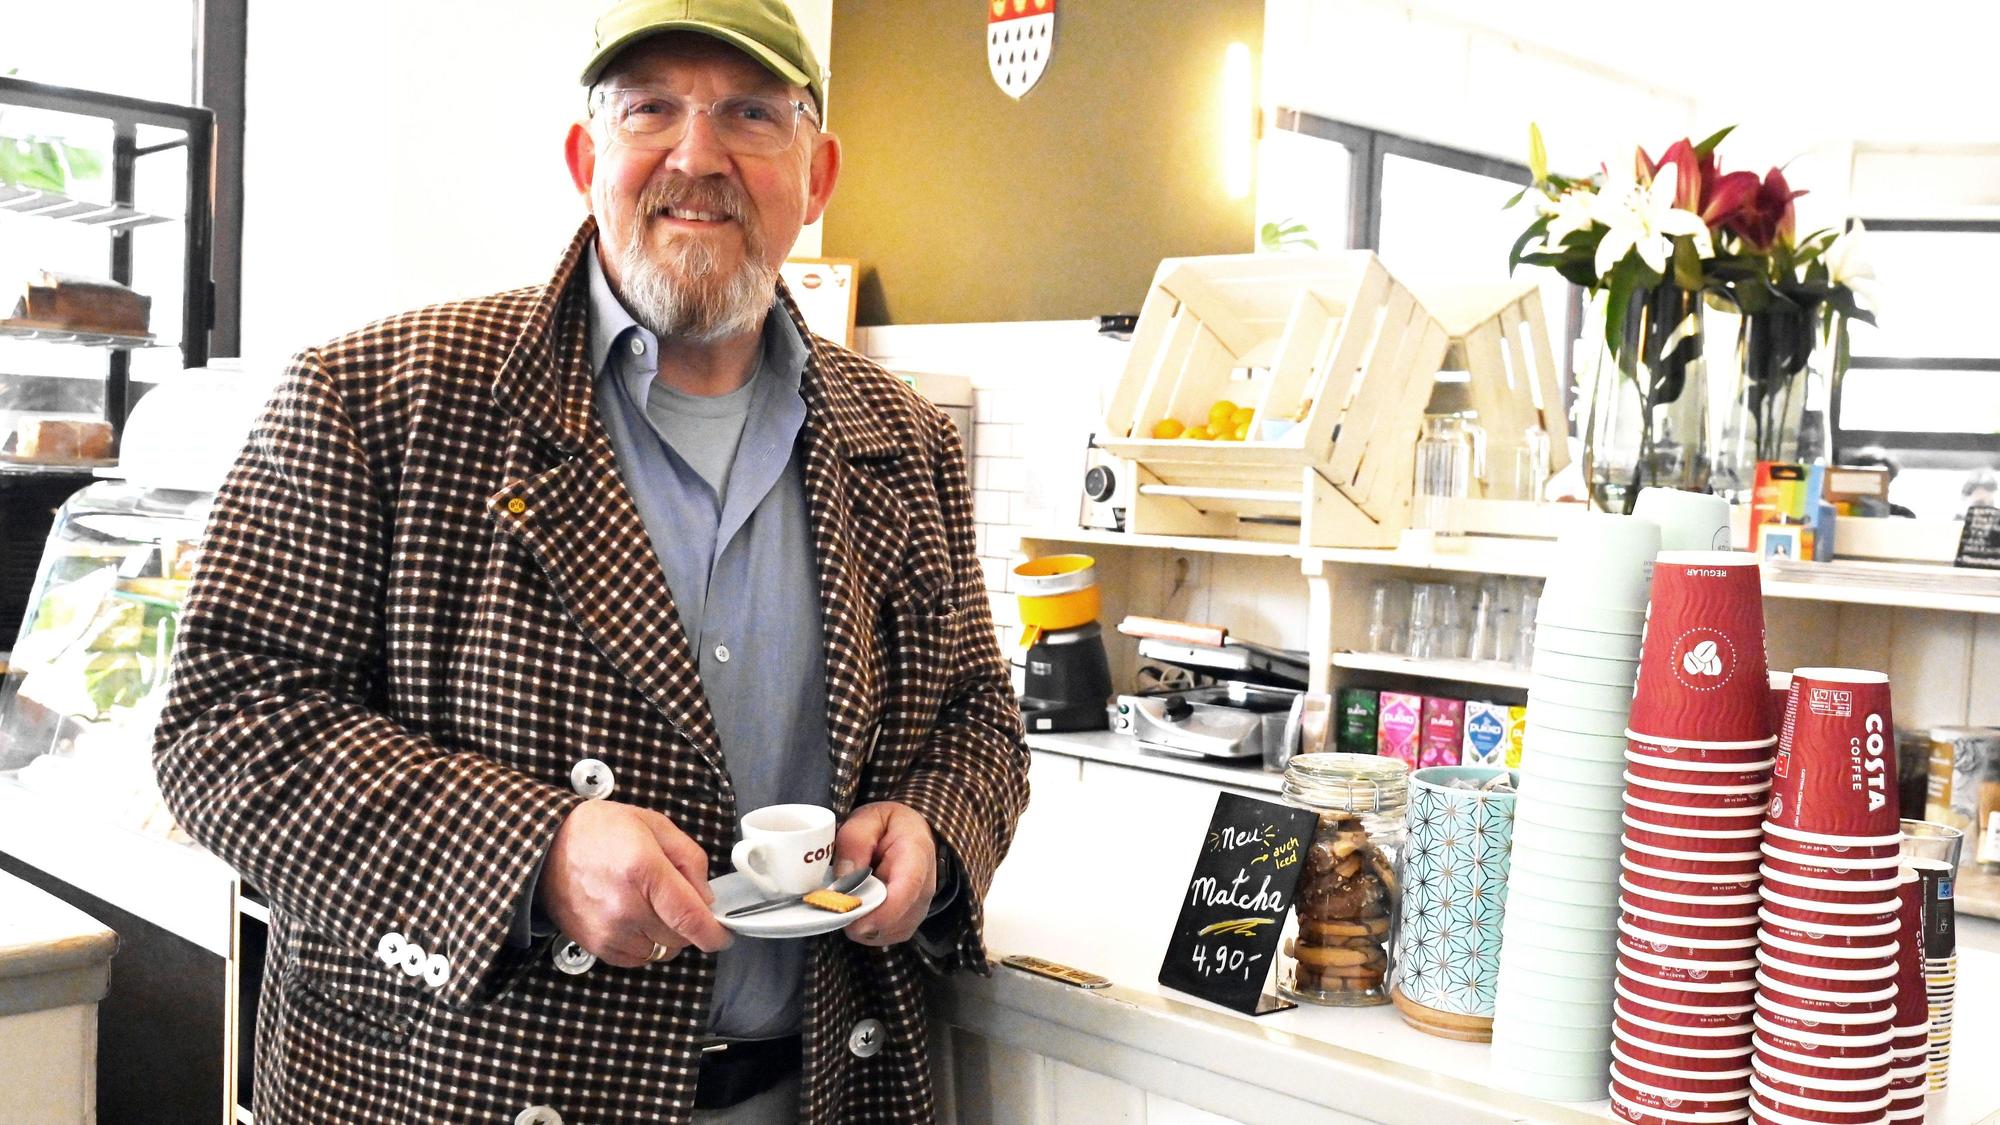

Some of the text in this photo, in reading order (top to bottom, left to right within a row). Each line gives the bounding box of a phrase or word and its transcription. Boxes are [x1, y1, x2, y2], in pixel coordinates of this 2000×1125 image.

[1686, 568, 1727, 577] REGULAR
[1850, 737, 1862, 791] COFFEE
[1864, 713, 1886, 812] COSTA
[1222, 826, 1262, 850] Neu
[1273, 837, 1299, 857] auch
[1191, 868, 1285, 912] Matcha
